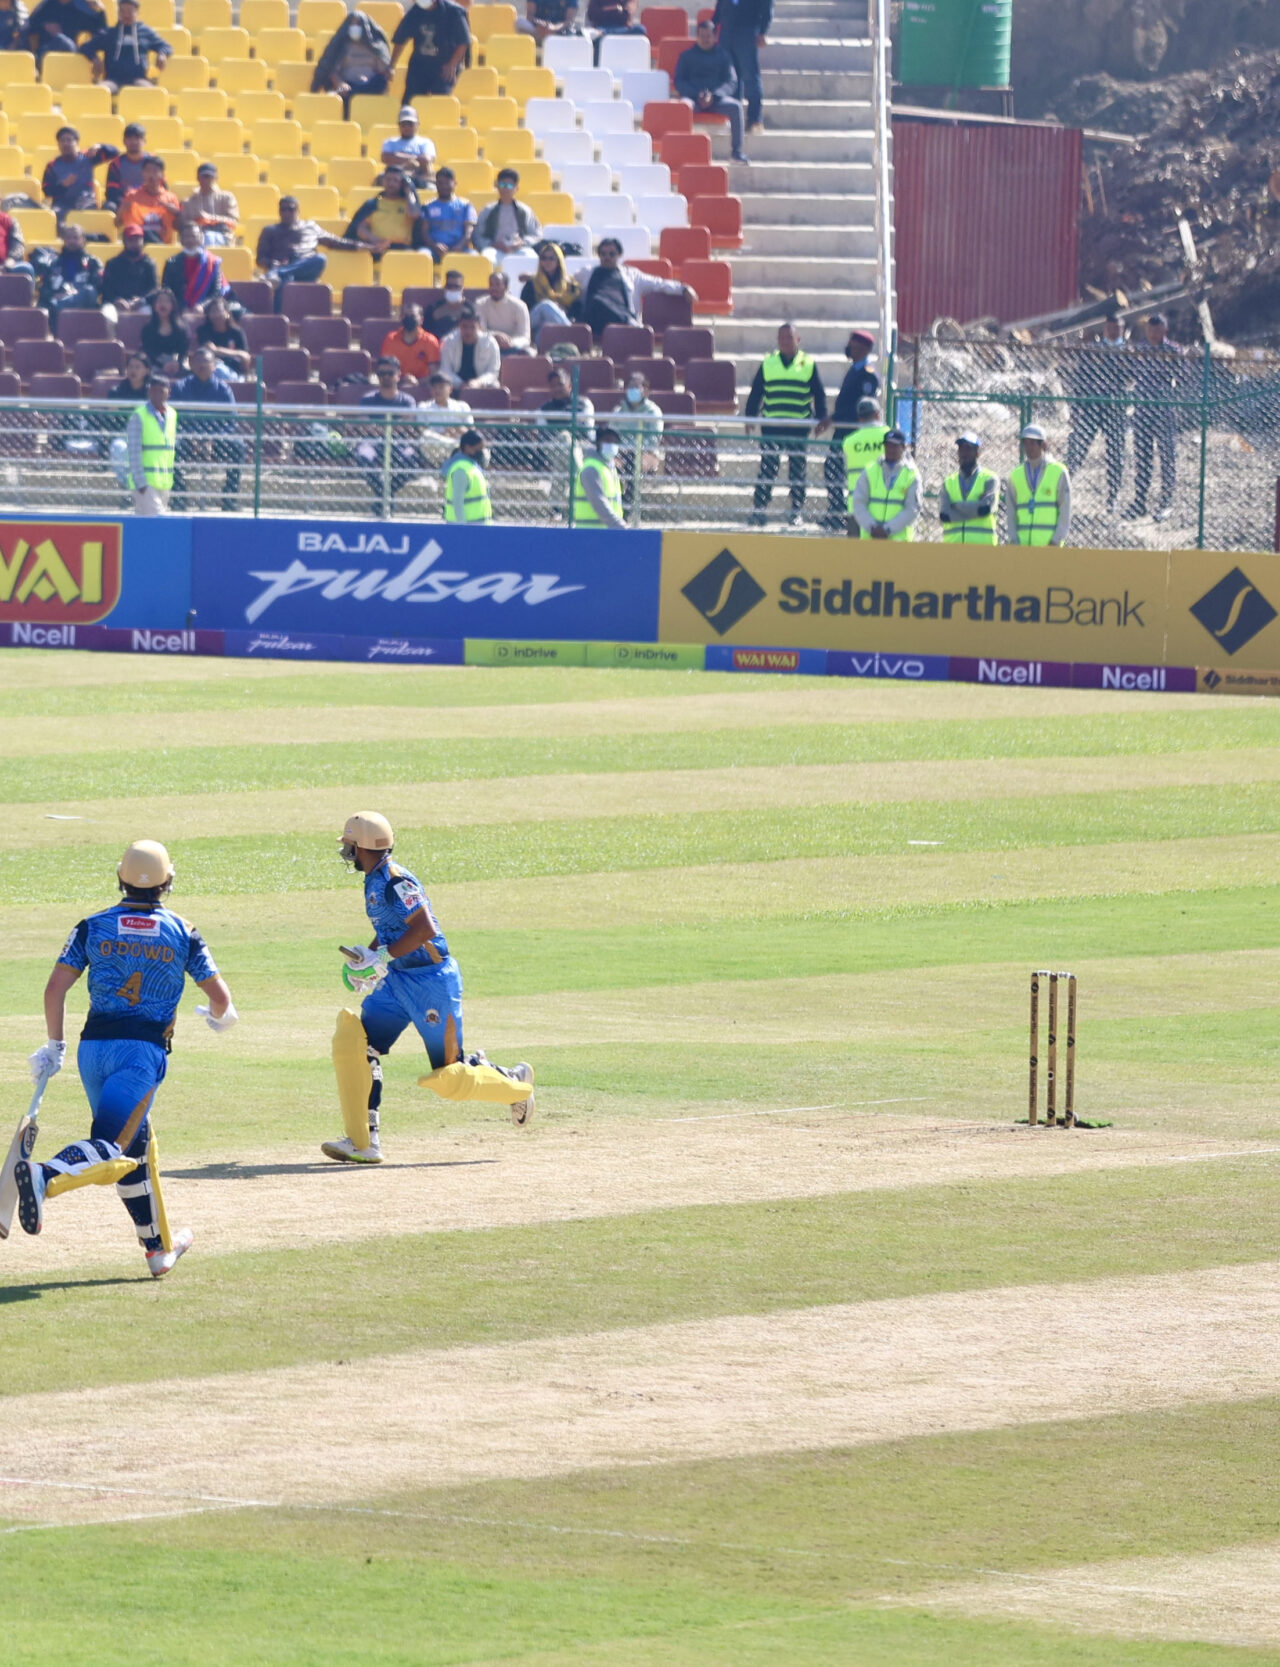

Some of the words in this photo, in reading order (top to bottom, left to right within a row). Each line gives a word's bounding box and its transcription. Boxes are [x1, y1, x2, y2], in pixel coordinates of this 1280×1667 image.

[298, 532, 410, 555] BAJAJ
[244, 537, 586, 625] pulsar
[11, 622, 76, 645] Ncell
[131, 629, 196, 652] Ncell
[514, 646, 558, 659] inDrive
[634, 649, 678, 662] inDrive
[735, 653, 766, 667] WAI
[767, 654, 797, 668] WAI
[851, 652, 925, 677] vivo
[977, 658, 1042, 684] Ncell
[1101, 665, 1166, 690] Ncell
[100, 940, 175, 963] O'DOWD
[116, 971, 143, 1007] 4
